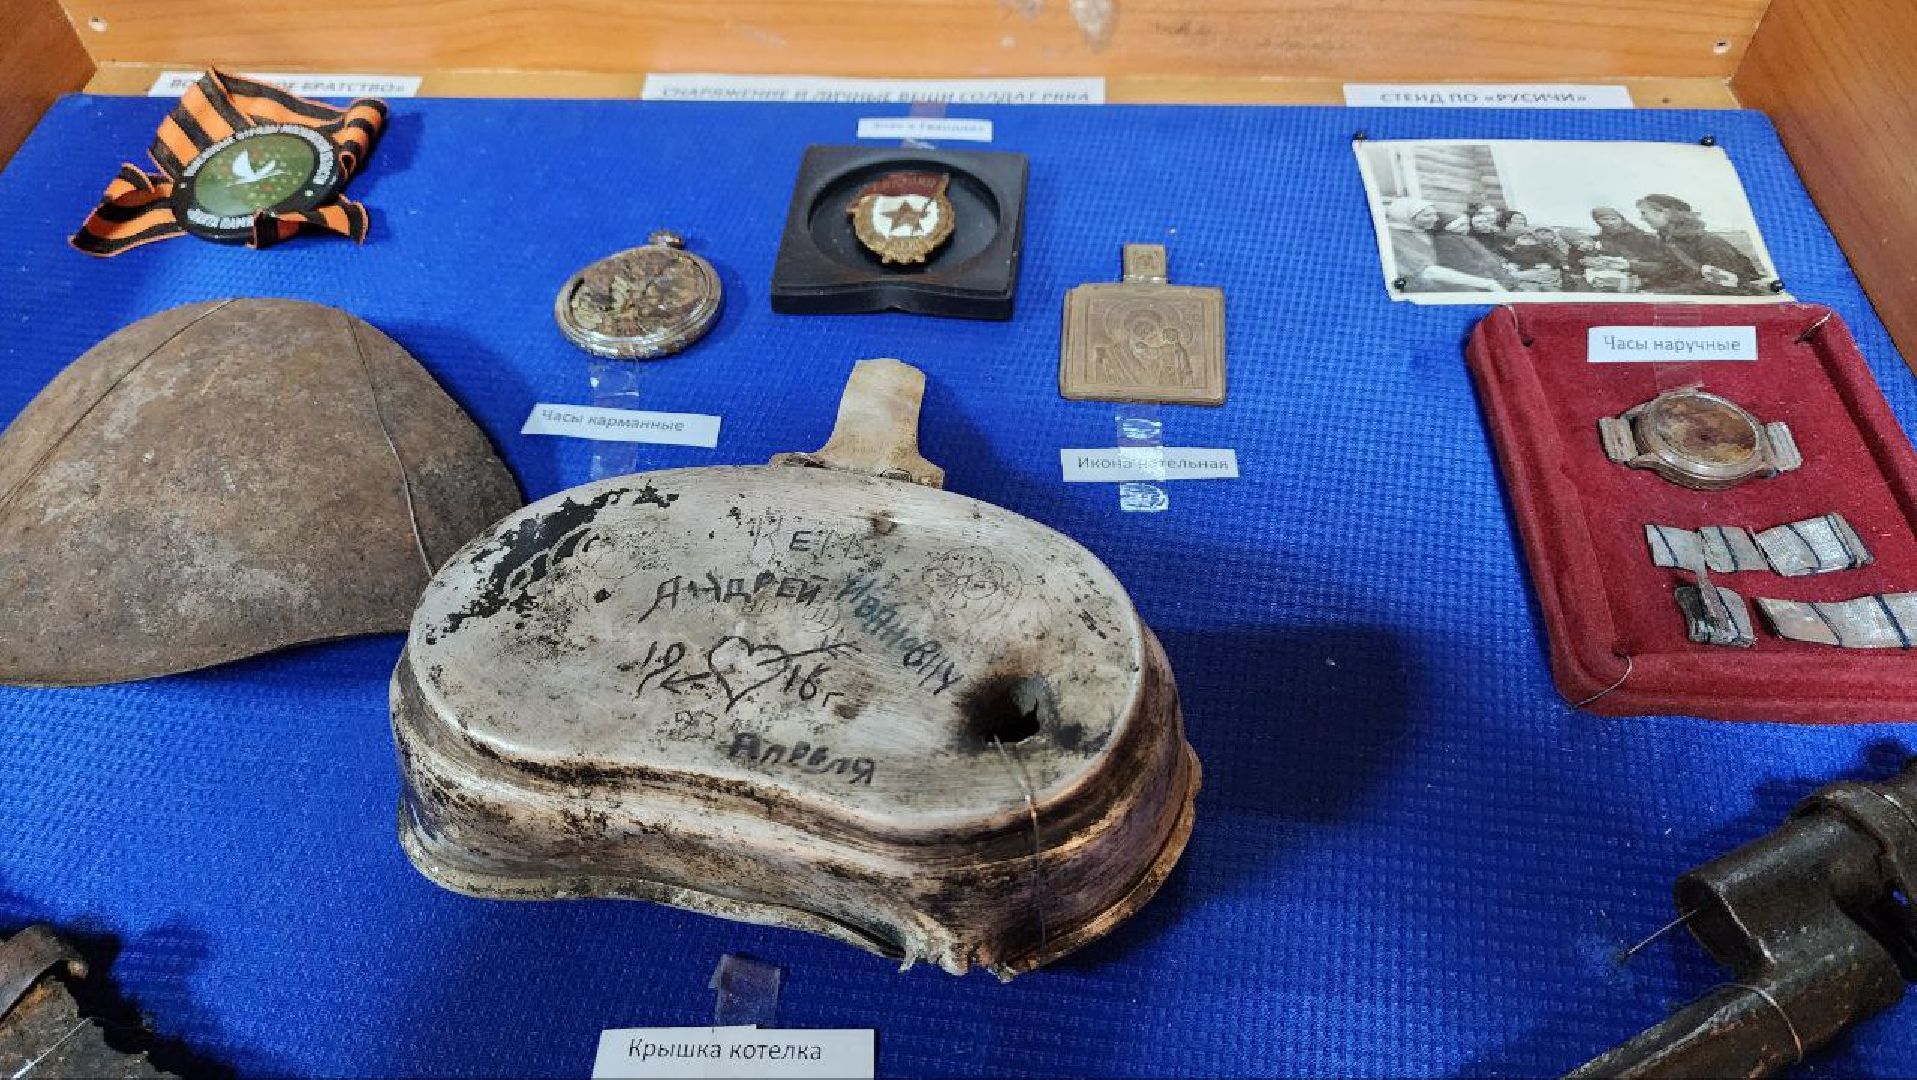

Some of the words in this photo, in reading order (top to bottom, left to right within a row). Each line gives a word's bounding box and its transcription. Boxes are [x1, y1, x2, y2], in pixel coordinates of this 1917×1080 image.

[1379, 92, 1445, 104] СТЕНД
[1448, 92, 1480, 104] ПО
[1484, 92, 1588, 104] «РУСИЧИ»
[1604, 335, 1648, 351] Часы
[1653, 338, 1741, 354] наручные
[542, 409, 585, 425] Часы
[587, 415, 686, 432] карманные
[1077, 456, 1133, 470] Икона
[628, 1038, 722, 1062] Крышка
[729, 1042, 822, 1061] котелка
